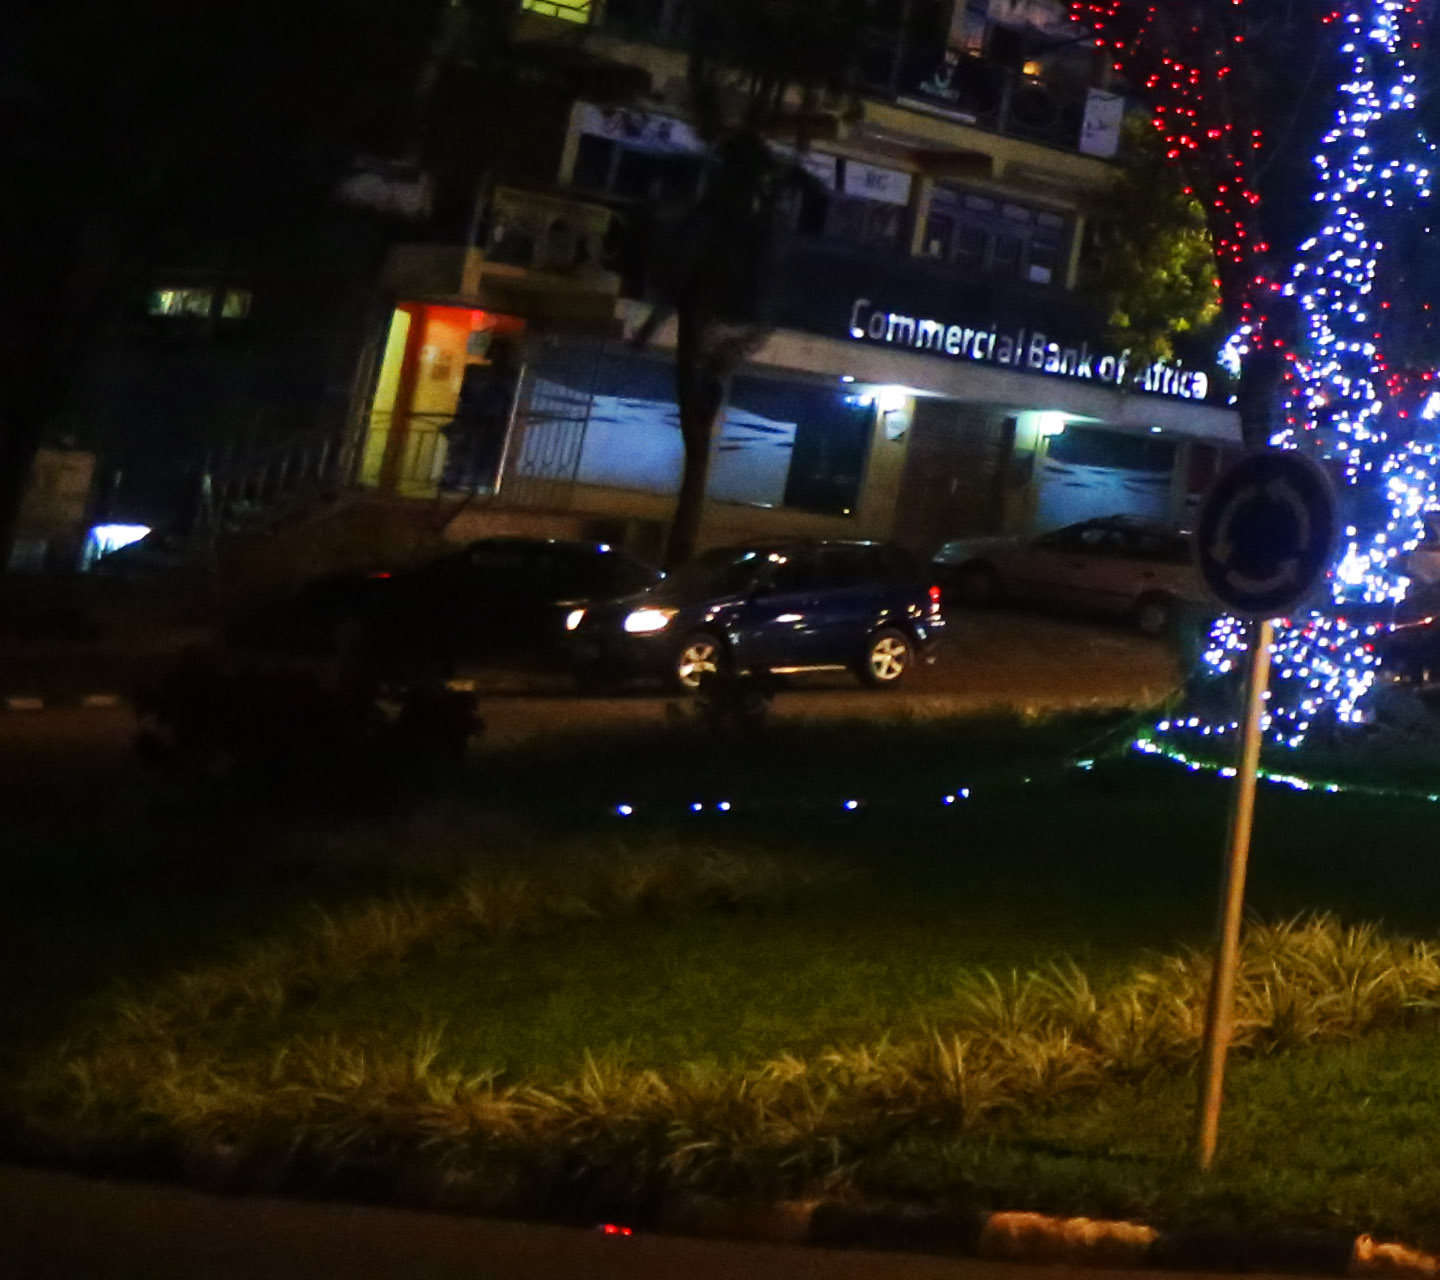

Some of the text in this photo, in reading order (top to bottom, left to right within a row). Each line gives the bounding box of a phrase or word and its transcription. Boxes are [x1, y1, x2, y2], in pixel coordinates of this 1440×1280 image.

[849, 298, 1023, 367] Commercial
[1027, 329, 1093, 380] Bank
[1098, 347, 1131, 386] of
